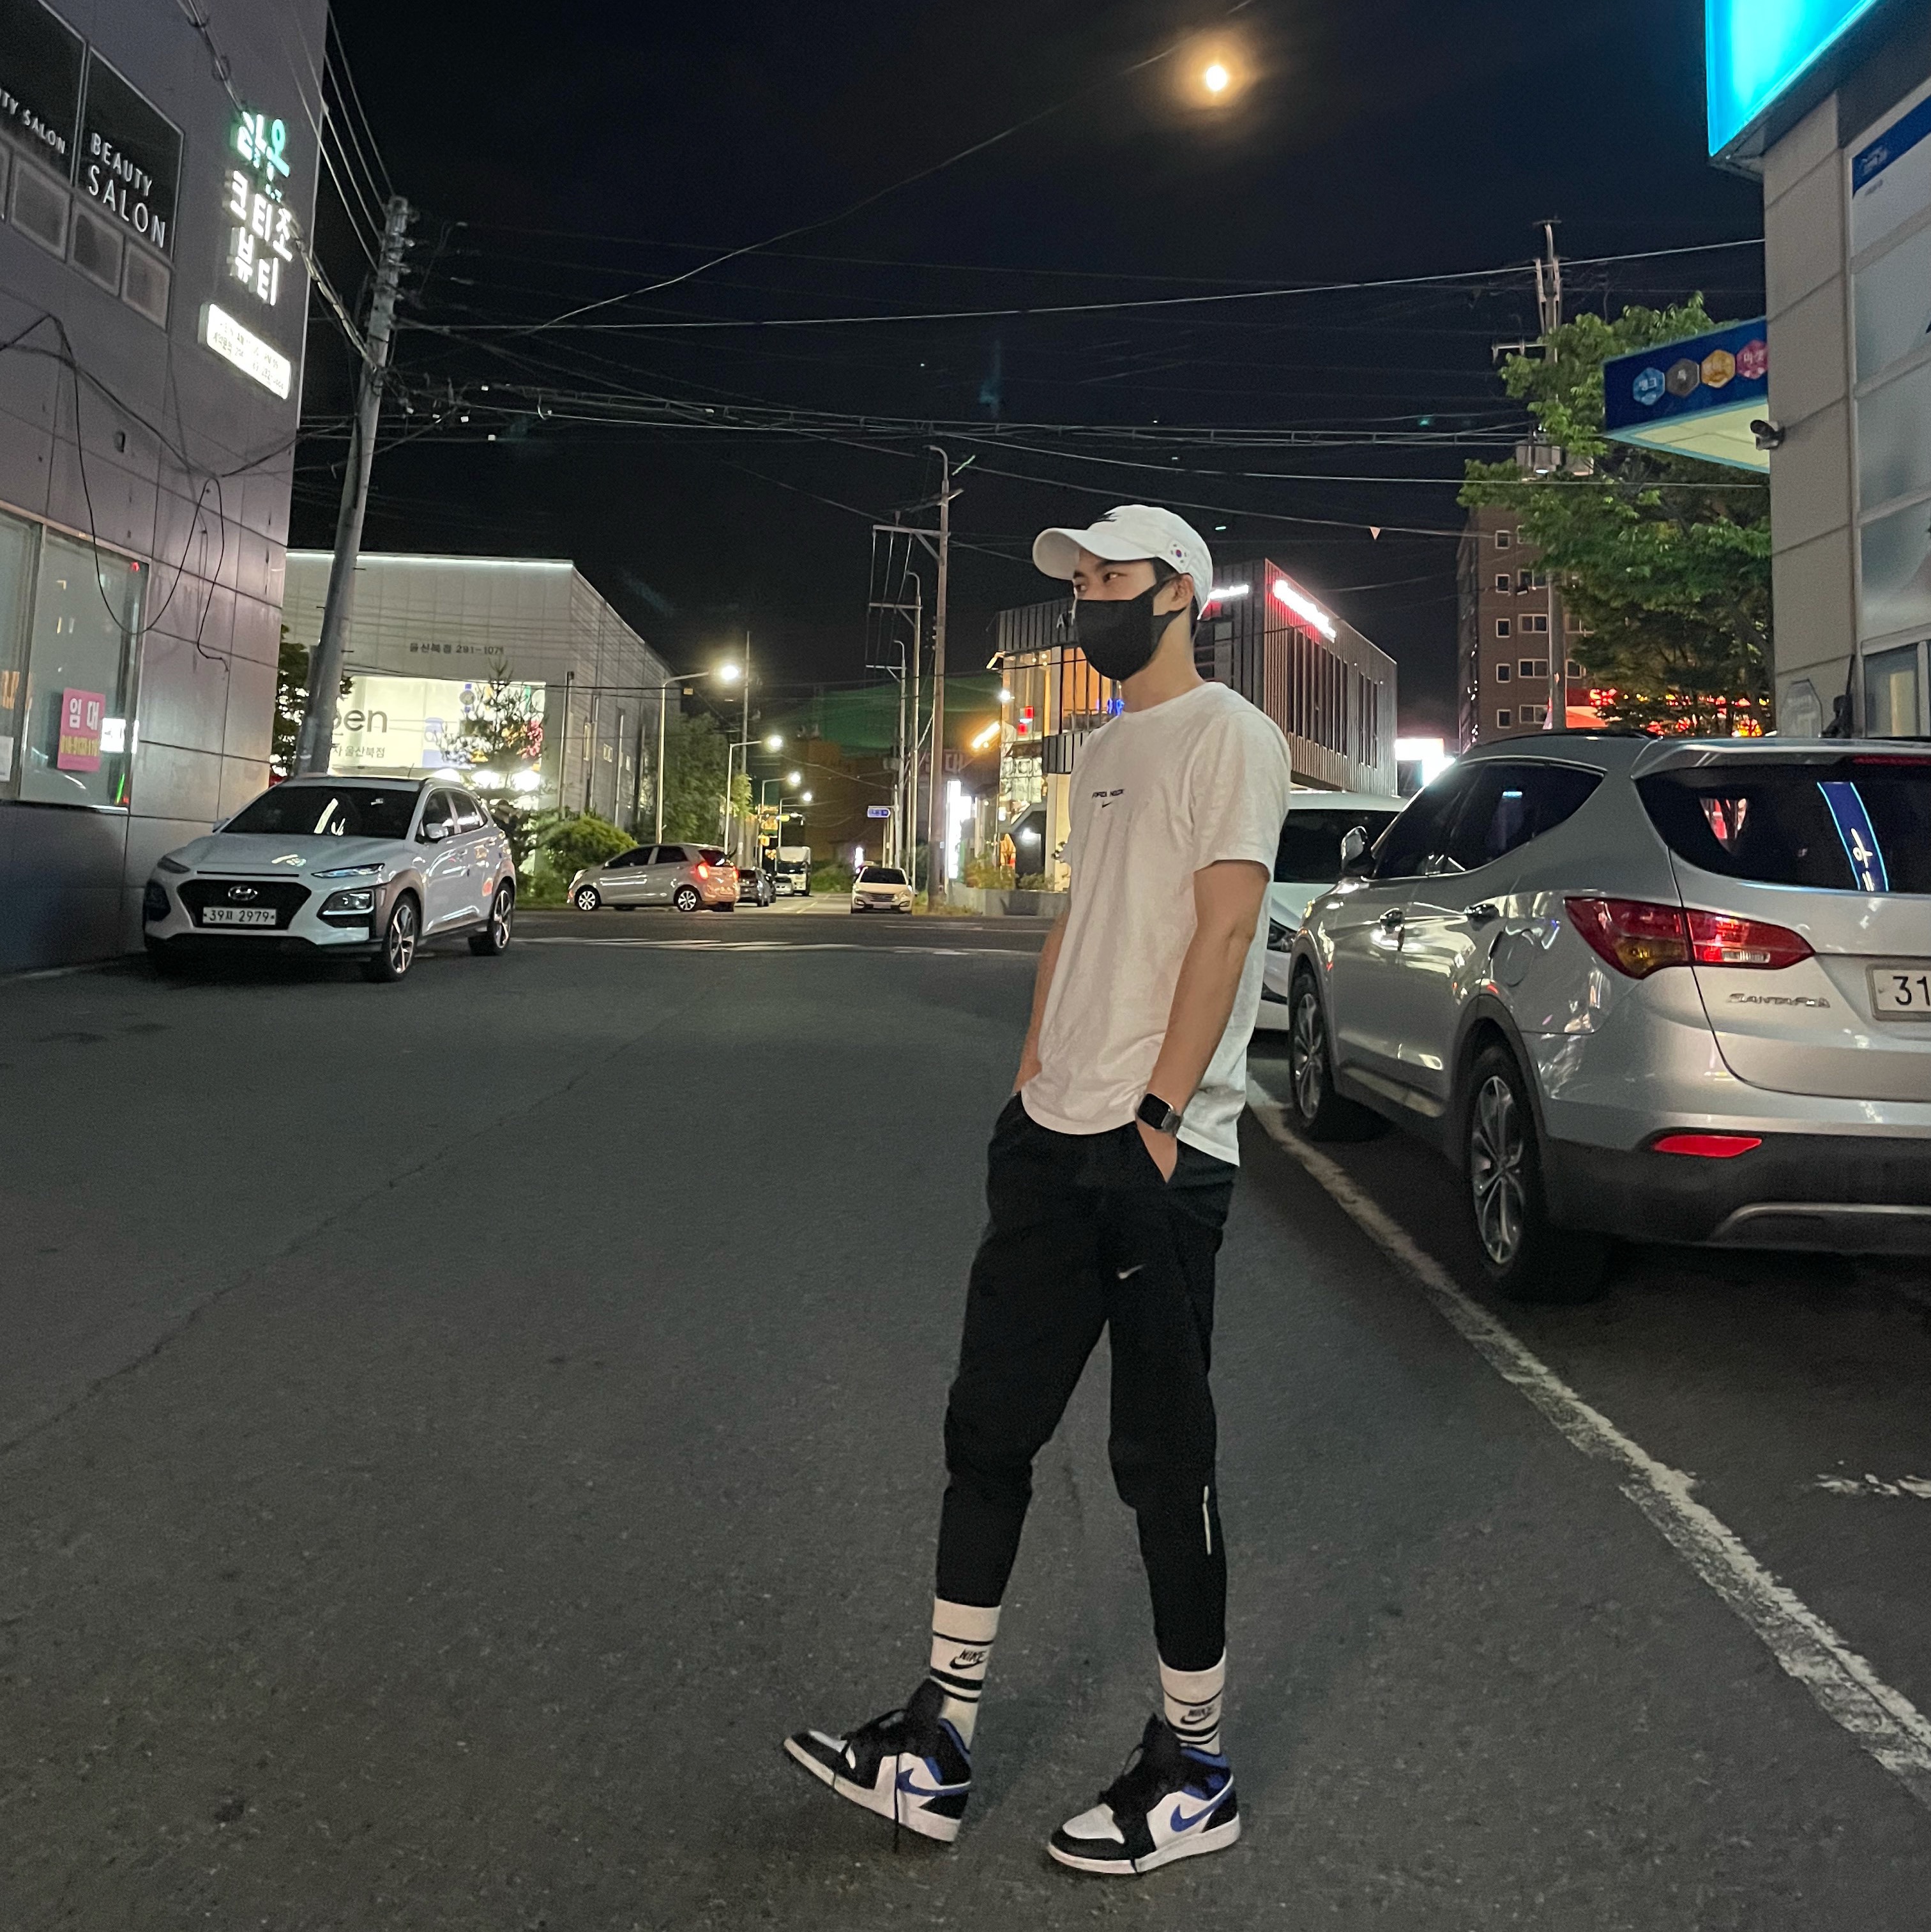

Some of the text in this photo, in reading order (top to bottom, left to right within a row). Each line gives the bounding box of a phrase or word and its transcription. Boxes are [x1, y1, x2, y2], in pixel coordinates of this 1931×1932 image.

[0, 88, 65, 154] TY SALON
[91, 132, 153, 197] BEAUTY
[88, 165, 165, 248] SALON
[234, 226, 278, 306] 뷰티
[69, 697, 100, 731] 임대
[239, 910, 269, 922] 2979
[1893, 975, 1930, 1006] 31
[959, 1648, 987, 1662] NIKE
